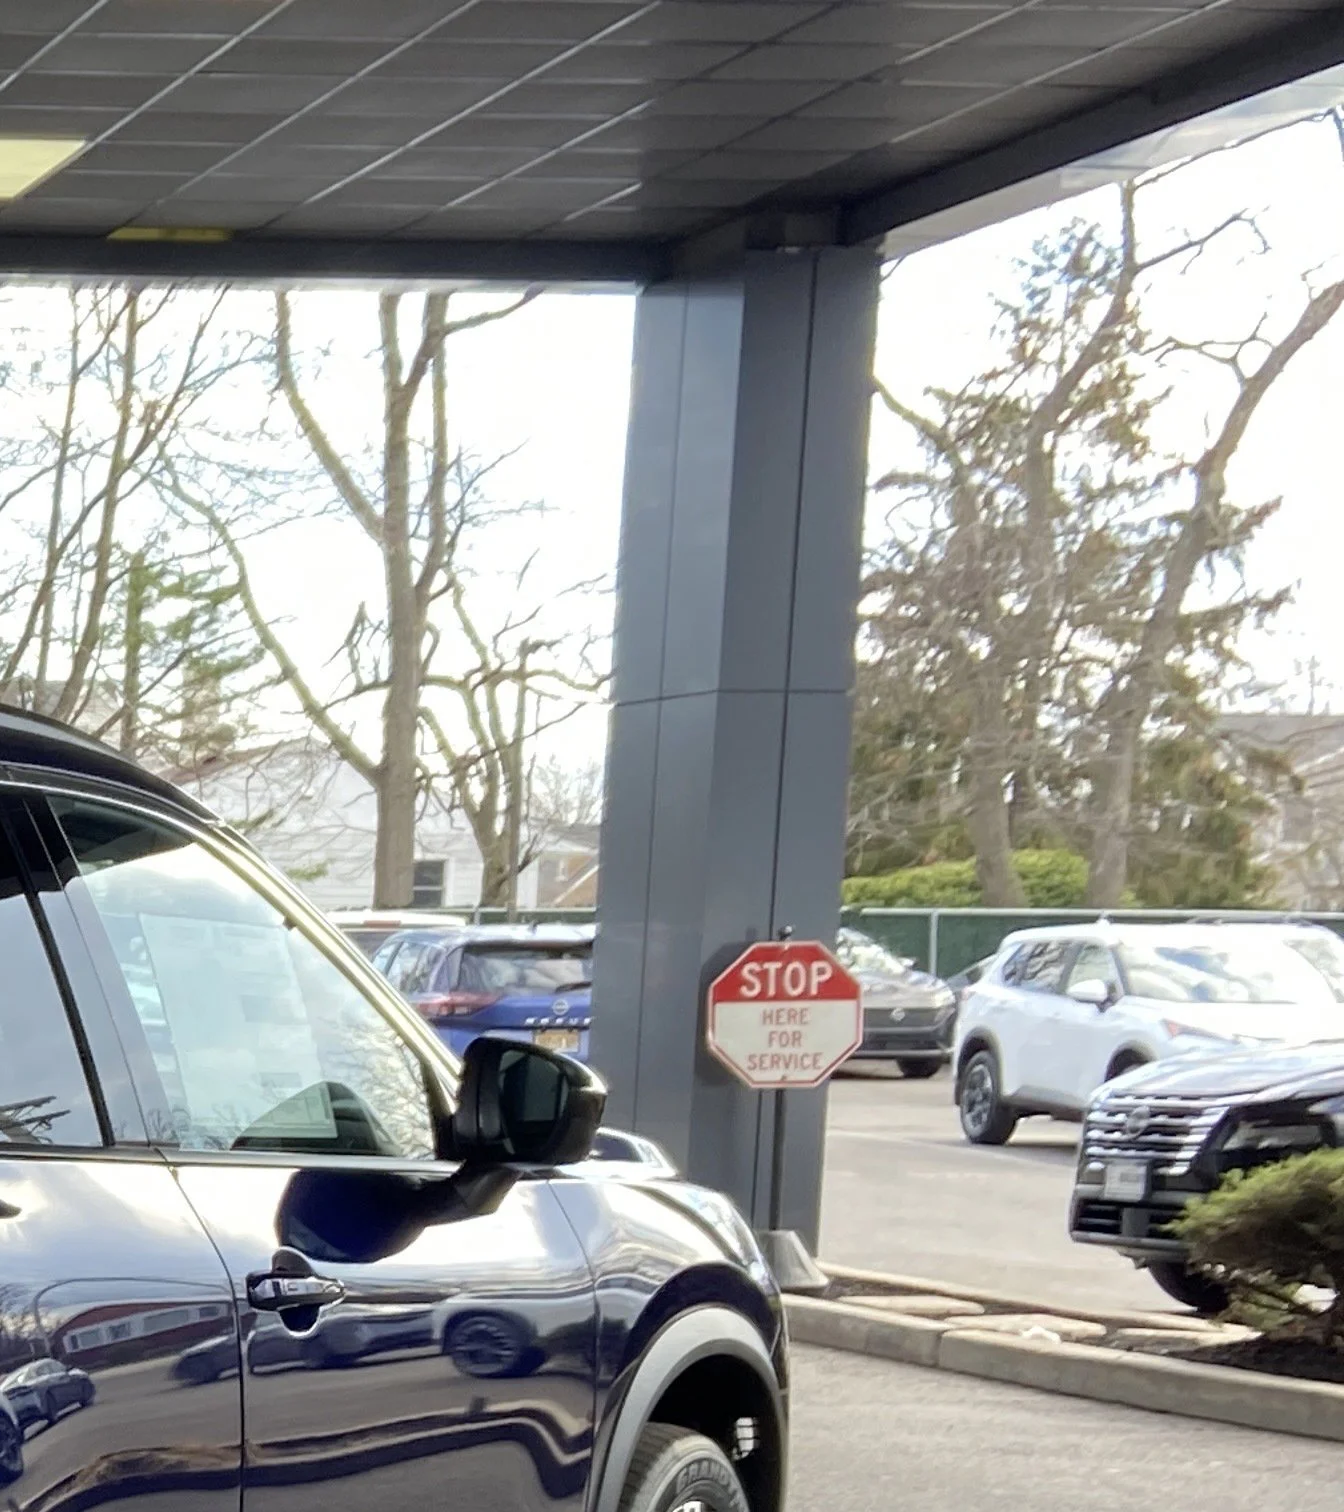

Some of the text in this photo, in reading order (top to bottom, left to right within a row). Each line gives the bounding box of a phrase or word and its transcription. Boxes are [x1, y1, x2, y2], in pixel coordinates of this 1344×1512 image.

[740, 960, 833, 998] STOP
[761, 1007, 811, 1026] HERE
[768, 1030, 803, 1048] FOR
[746, 1052, 824, 1071] SERVICE
